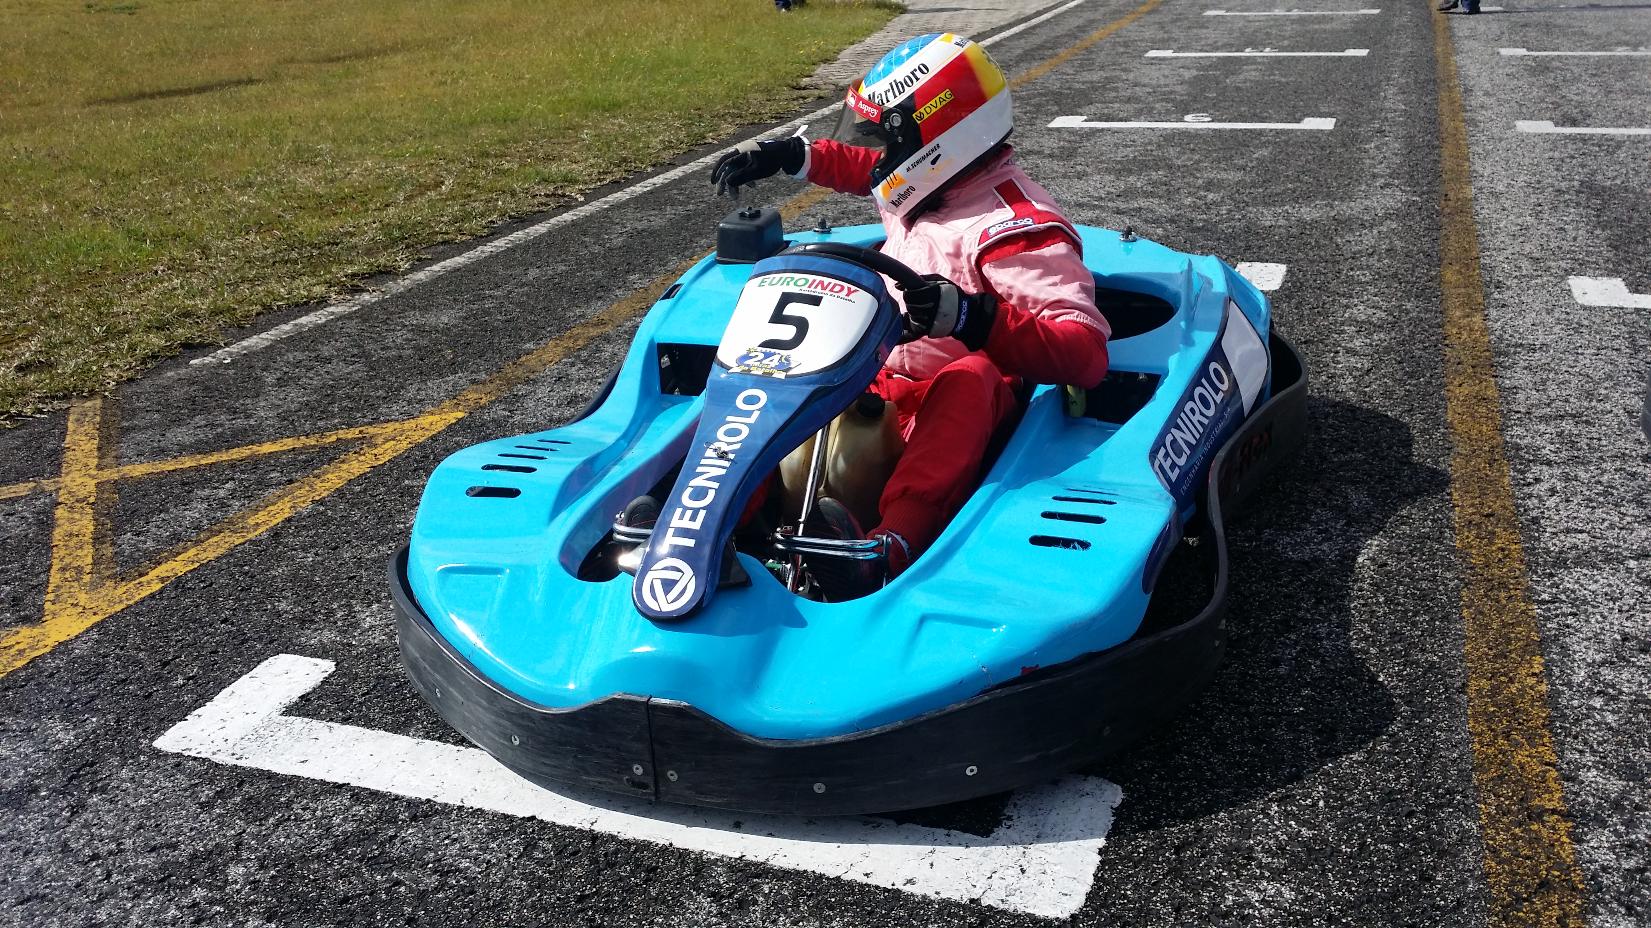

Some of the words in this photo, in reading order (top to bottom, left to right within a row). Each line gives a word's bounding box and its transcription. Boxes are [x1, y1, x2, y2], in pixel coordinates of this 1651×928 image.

[857, 100, 879, 118] Asprey
[924, 91, 953, 116] DVAG
[890, 185, 916, 209] Marlboro
[758, 291, 823, 351] 5
[743, 352, 781, 367] 24
[1153, 361, 1229, 490] TECNIROLO
[657, 388, 768, 554] TECNIROLO
